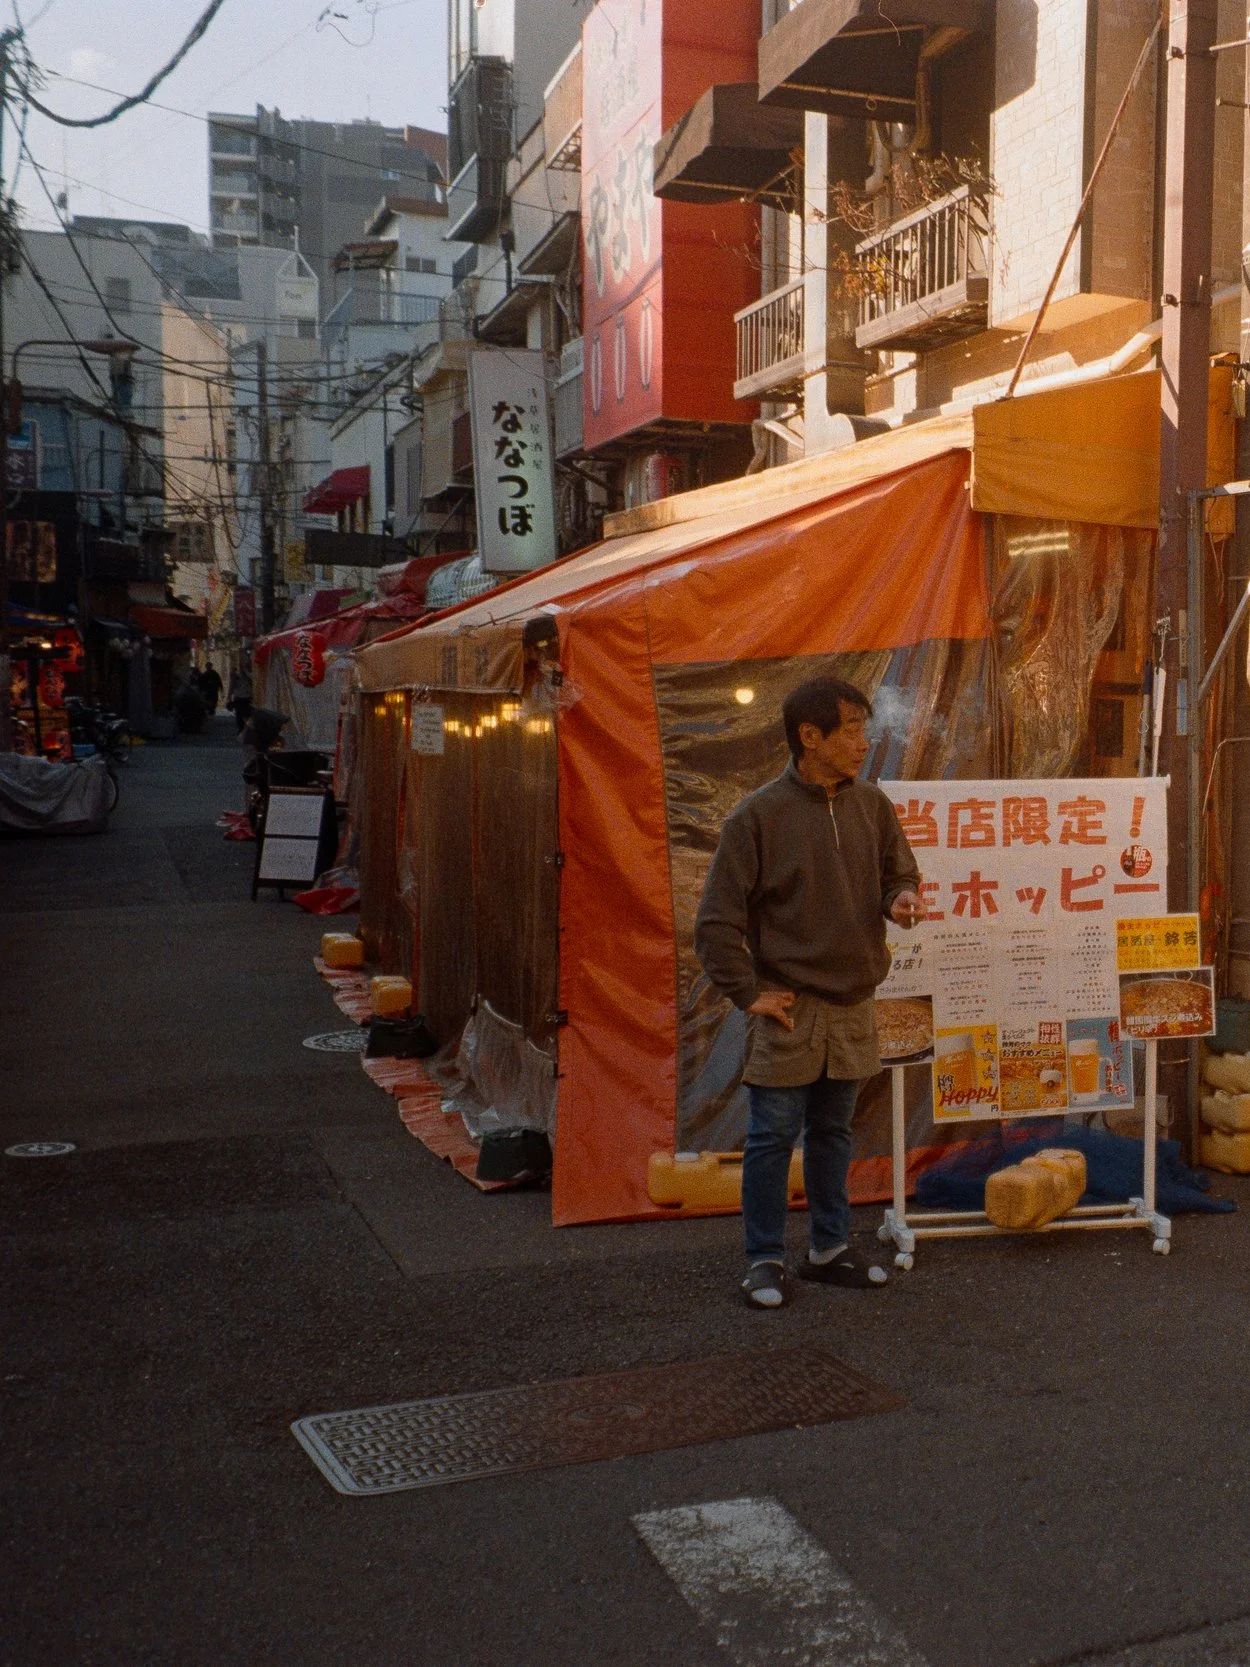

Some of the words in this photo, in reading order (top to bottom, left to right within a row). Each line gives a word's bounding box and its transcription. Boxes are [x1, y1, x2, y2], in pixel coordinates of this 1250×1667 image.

[491, 400, 535, 537] ななつぼ
[938, 1086, 998, 1107] Hoppy
